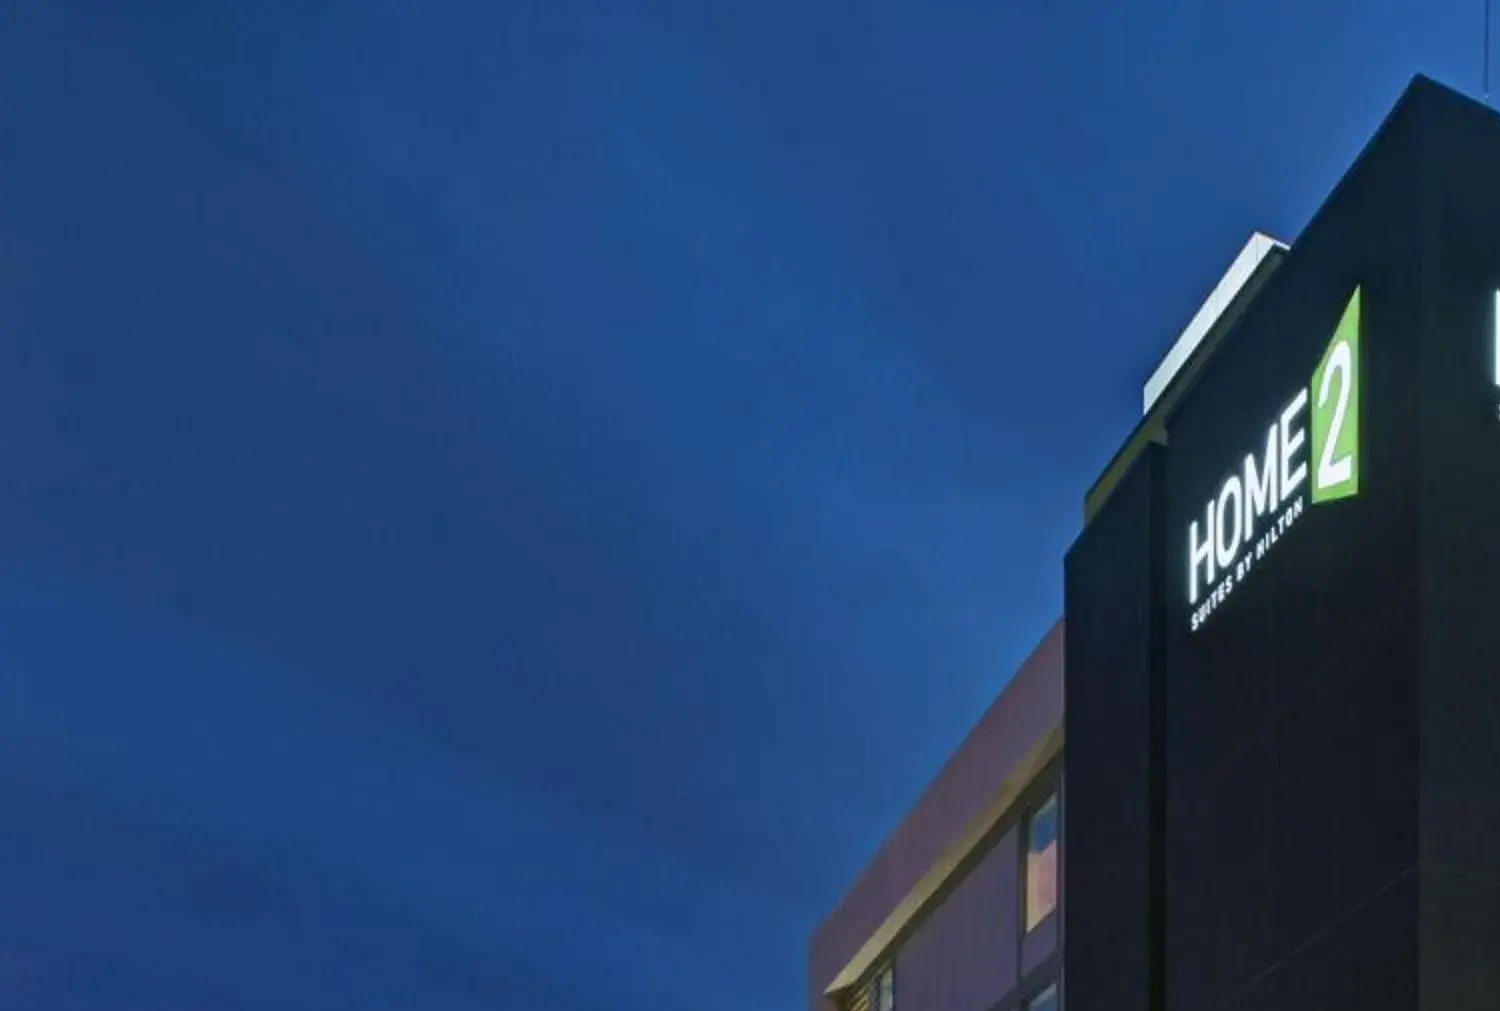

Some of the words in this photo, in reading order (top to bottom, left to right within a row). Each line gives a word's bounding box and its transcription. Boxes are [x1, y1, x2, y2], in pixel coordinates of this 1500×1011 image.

[1188, 386, 1308, 605] HOME
[1317, 339, 1352, 490] 2
[1191, 574, 1234, 631] SUITES
[1236, 550, 1254, 582] BY
[1255, 495, 1304, 560] HILTON
